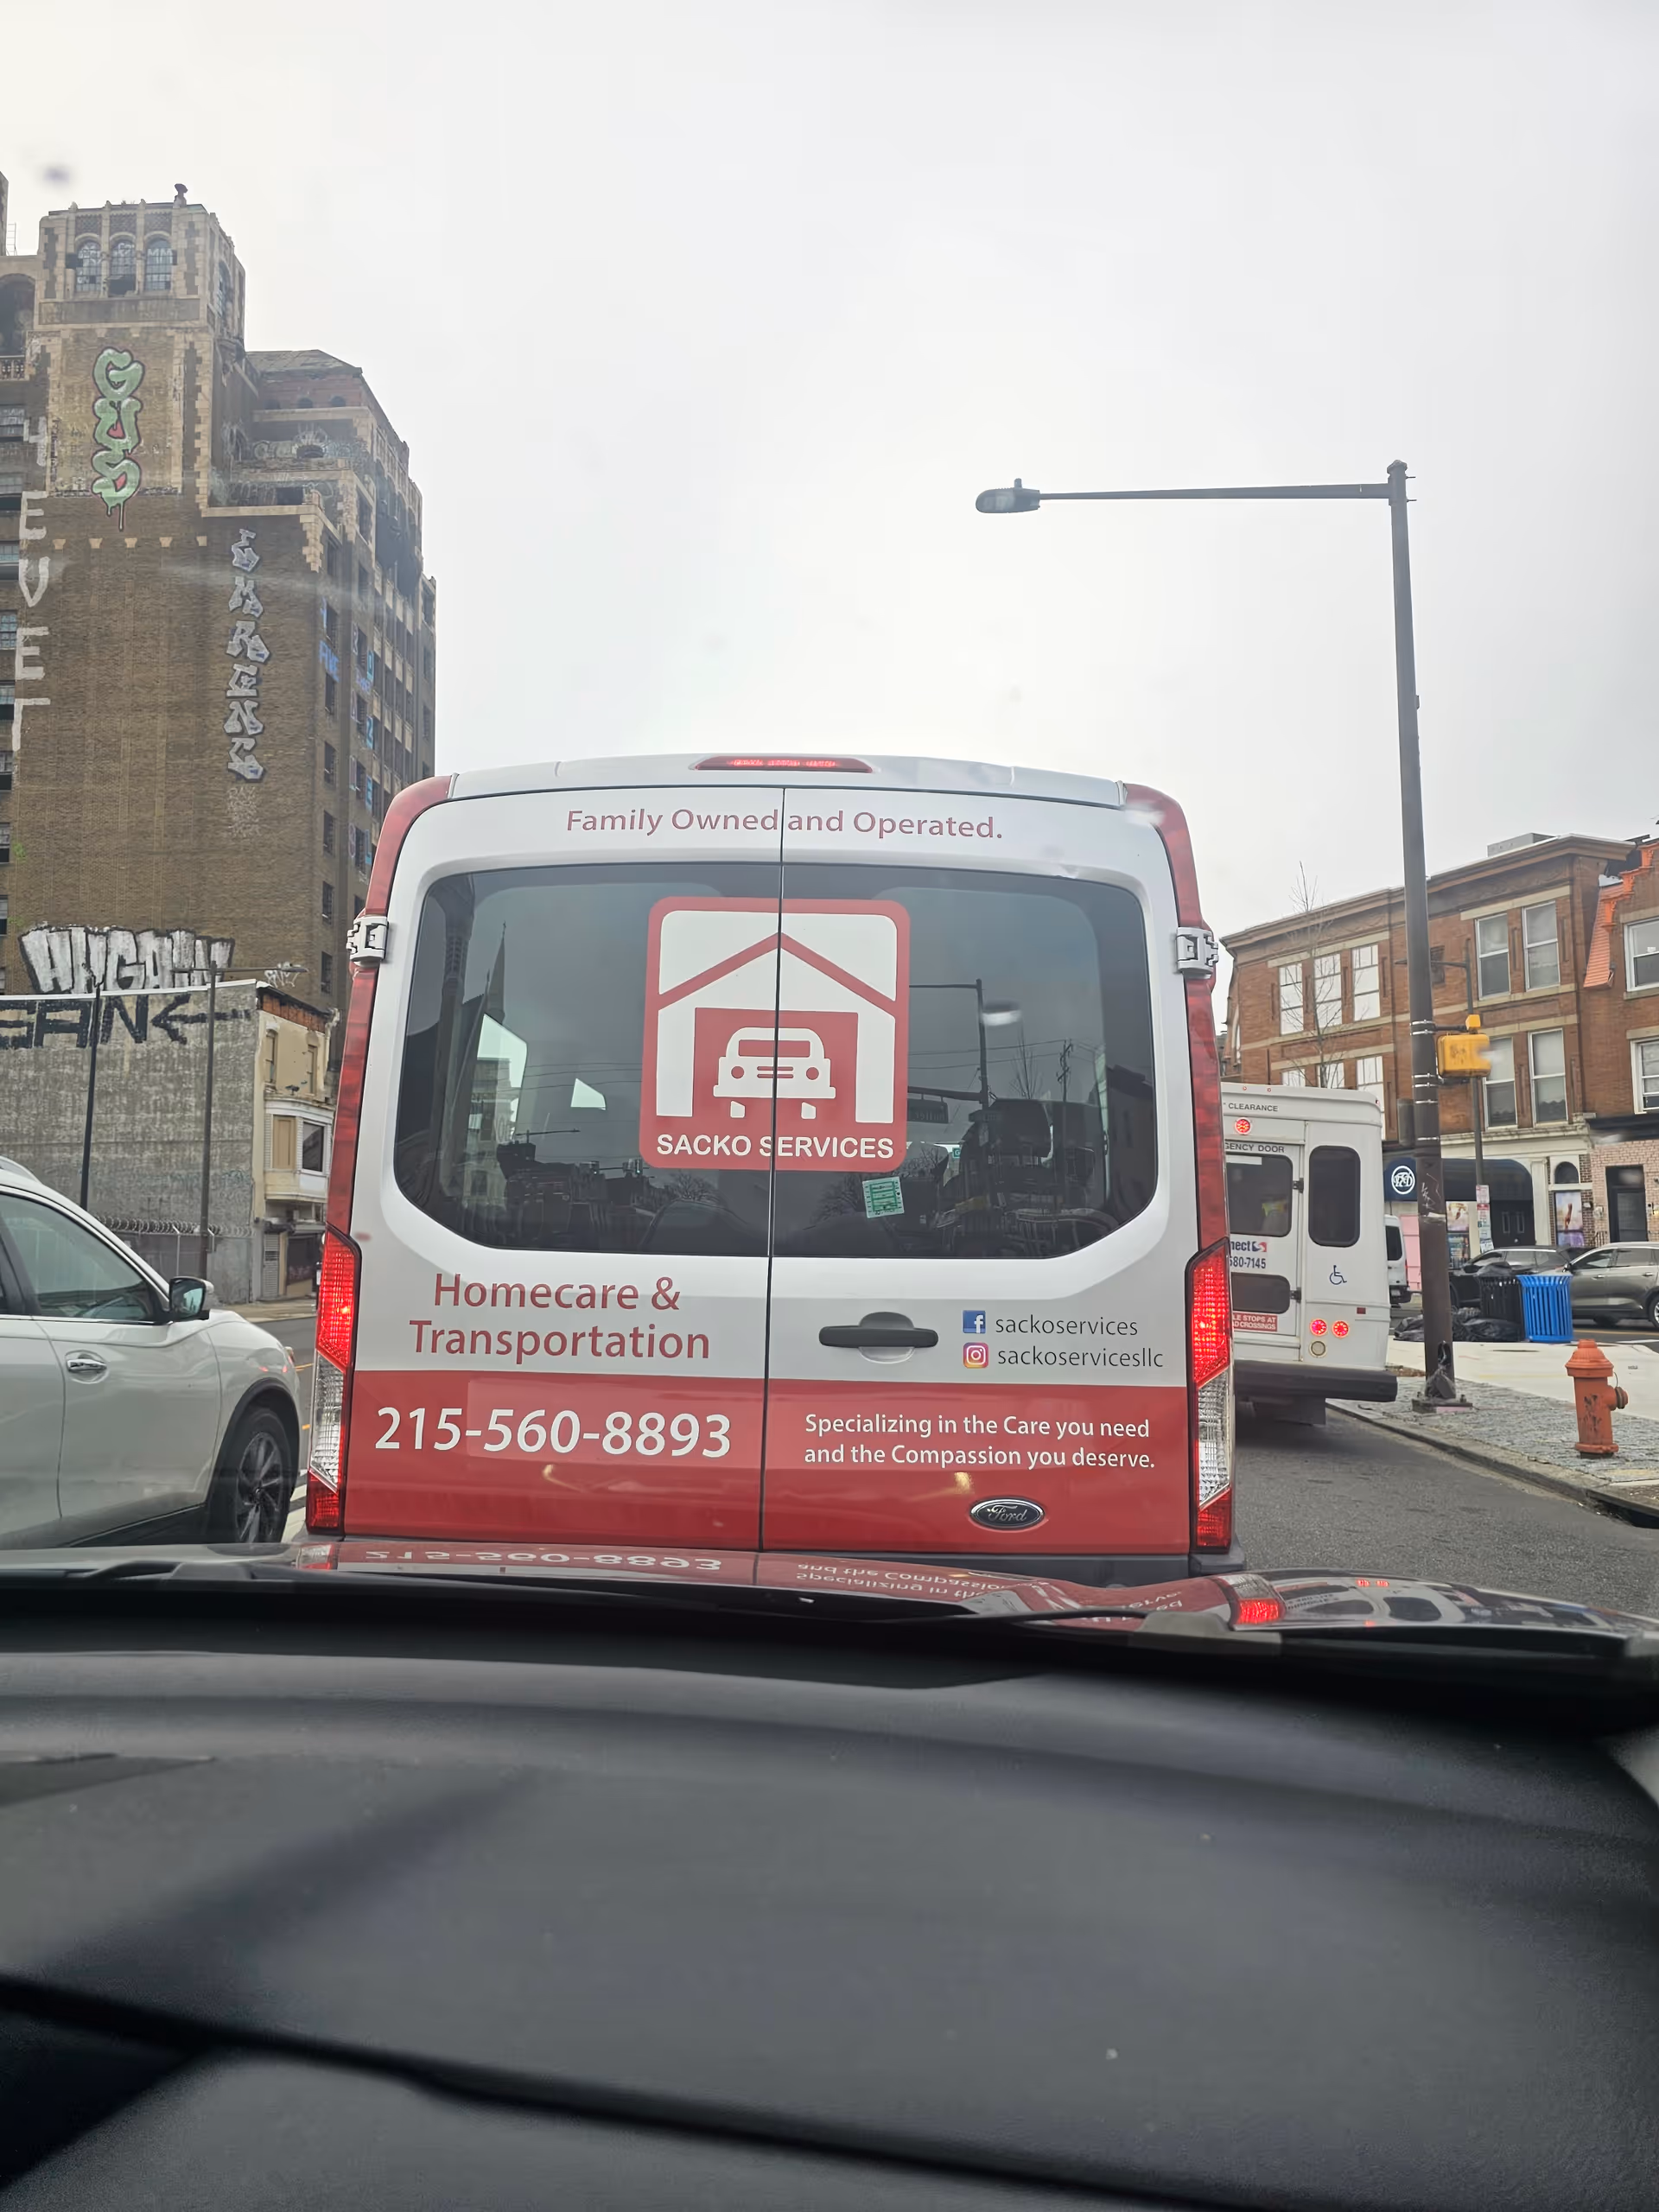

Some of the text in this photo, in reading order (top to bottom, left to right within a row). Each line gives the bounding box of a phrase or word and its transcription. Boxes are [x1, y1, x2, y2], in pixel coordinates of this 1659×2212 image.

[567, 808, 1002, 841] Family Owned and Operated.
[1228, 1103, 1279, 1112] CLEARANCE
[657, 1134, 893, 1159] SACKO SERVICES
[1258, 1145, 1285, 1154] DOOR
[434, 1273, 681, 1311] Homecare &
[995, 1313, 1138, 1336] sackoservices
[1240, 1321, 1276, 1331] CROSSINGS
[1243, 1314, 1266, 1323] STOPS
[409, 1319, 709, 1365] Transportation
[997, 1344, 1164, 1368] sackoservicesllc
[375, 1407, 730, 1459] 215-560-8893
[805, 1413, 1149, 1440] Specializing in the Care you need
[804, 1443, 1155, 1471] and the Compassion you deserve.
[987, 1504, 1028, 1522] Ford
